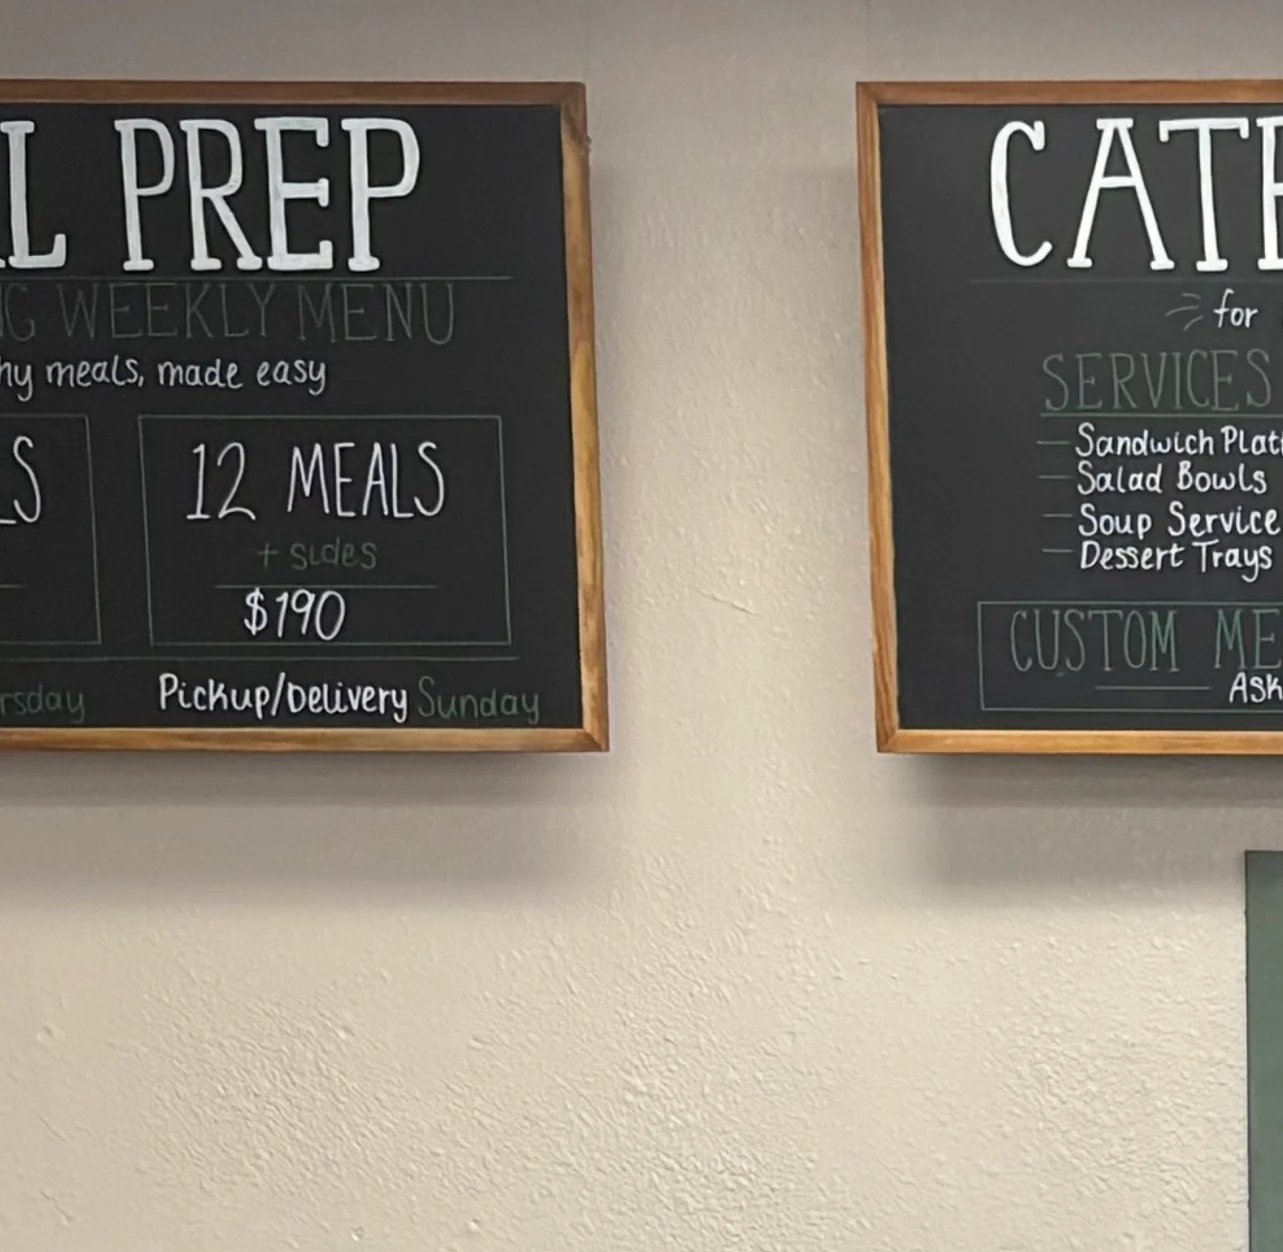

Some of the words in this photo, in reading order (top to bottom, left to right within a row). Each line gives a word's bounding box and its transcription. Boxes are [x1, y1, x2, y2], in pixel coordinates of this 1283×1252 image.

[0, 121, 66, 268] L
[115, 117, 419, 271] PREP
[0, 283, 36, 342] G
[58, 281, 275, 339] WEEKLY
[300, 282, 457, 345] MENU
[1214, 289, 1258, 327] for
[46, 355, 144, 387] meals,
[158, 359, 243, 388] made
[257, 360, 325, 395] easy
[1043, 348, 1271, 411] SERVICES
[1076, 422, 1213, 457] Sandwich
[187, 442, 256, 520] 12
[288, 442, 444, 517] MEALS
[1078, 462, 1162, 495] Salad
[1177, 460, 1266, 494] Bowls
[1078, 502, 1153, 543] Soup
[1168, 502, 1280, 537] Service
[290, 537, 376, 570] sides
[1081, 540, 1184, 570] Dessert
[1192, 539, 1272, 582] Trays
[244, 587, 345, 640] $190
[1011, 608, 1179, 672] CUSTOM
[160, 672, 407, 722] Pickup/Delivery
[418, 676, 539, 724] Sunday
